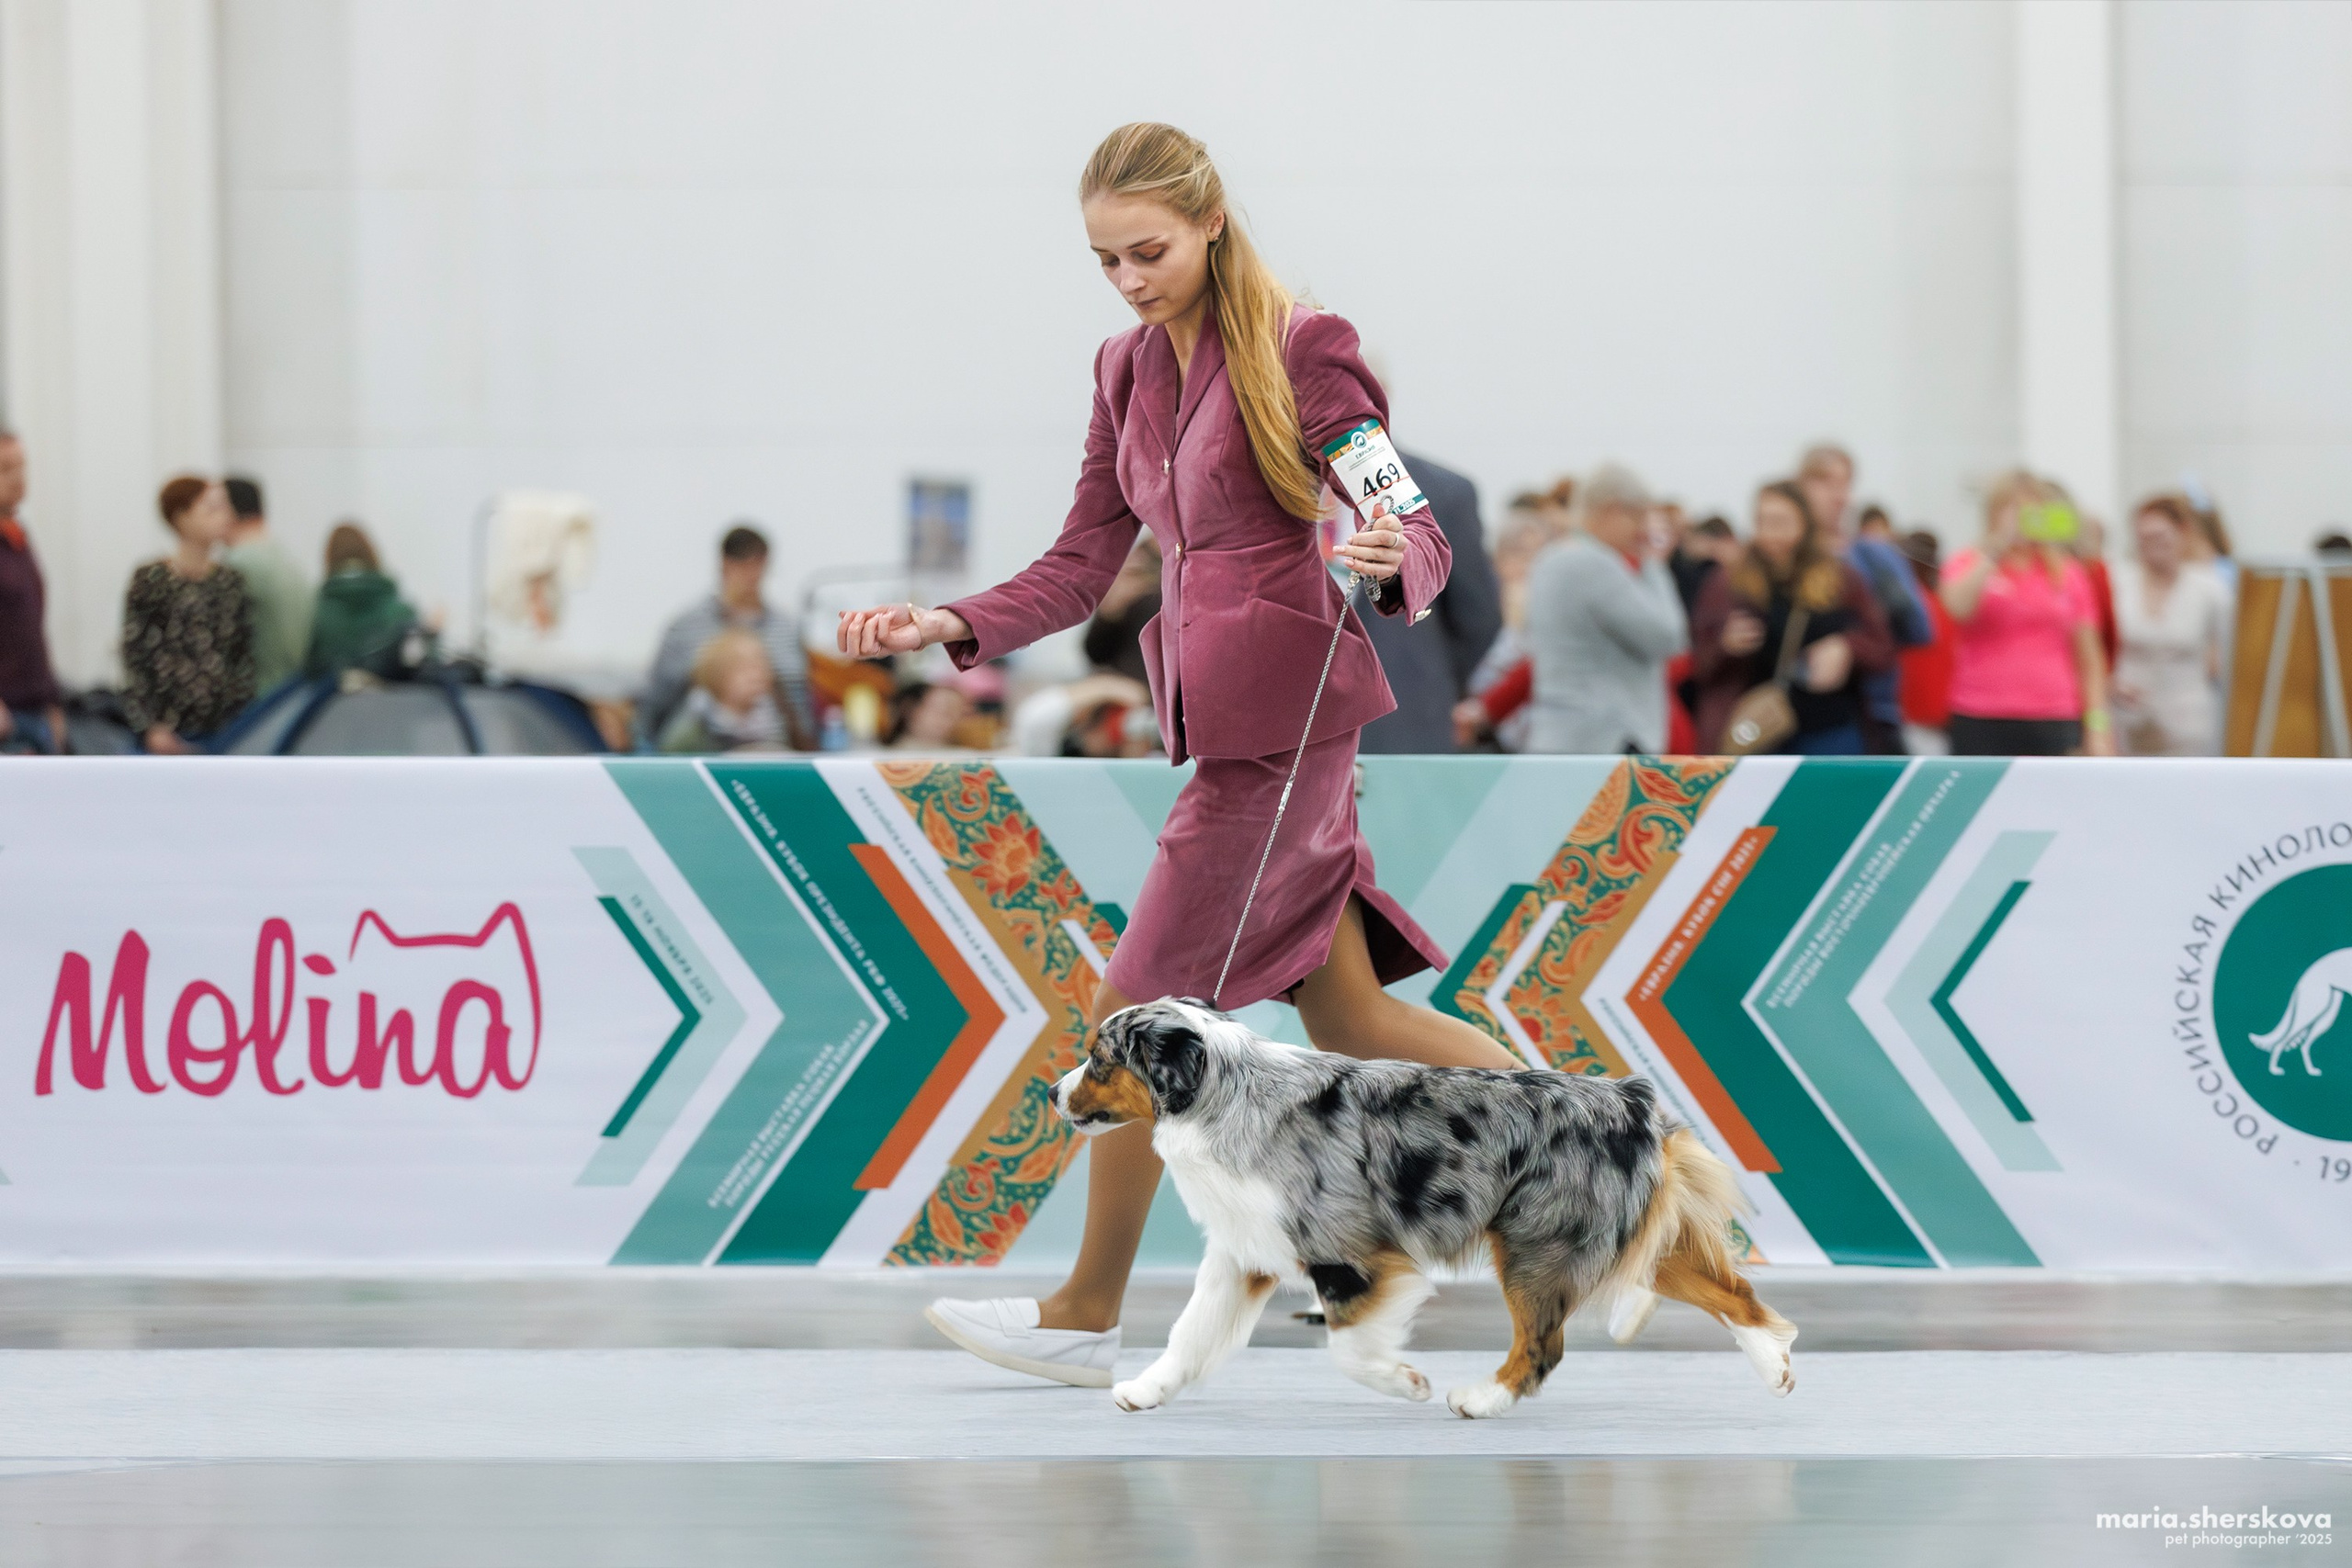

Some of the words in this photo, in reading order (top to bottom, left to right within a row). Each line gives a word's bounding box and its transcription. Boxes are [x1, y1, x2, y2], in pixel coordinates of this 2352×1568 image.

[1364, 463, 1400, 497] 469
[2209, 822, 2352, 910] КИНОЛО
[35, 901, 541, 1099] Molina
[2173, 916, 2278, 1155] РОССИЙСКАЯ
[2319, 1155, 2352, 1183] 19
